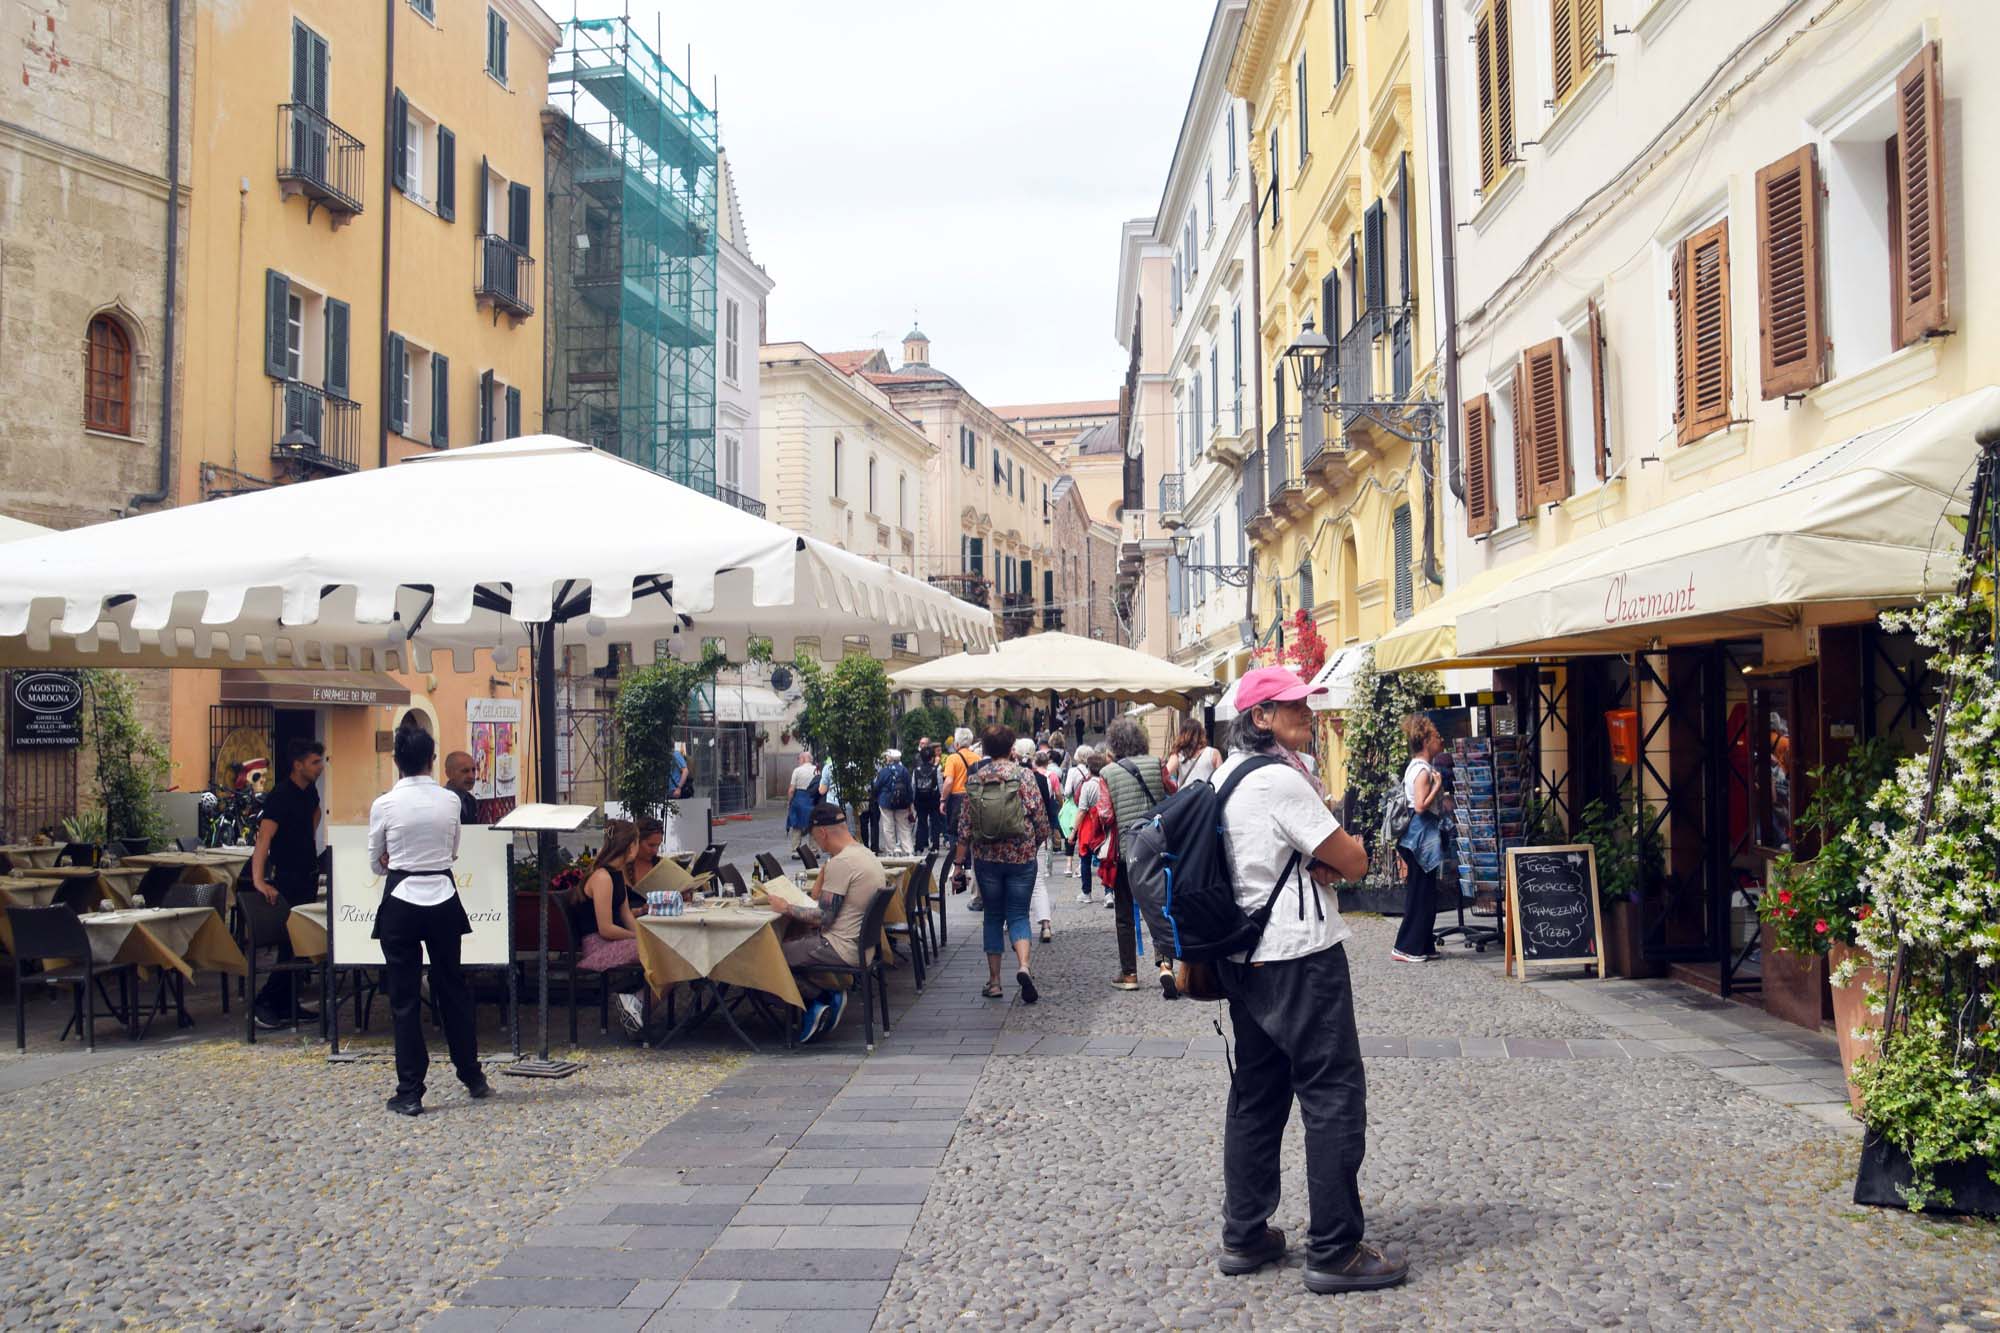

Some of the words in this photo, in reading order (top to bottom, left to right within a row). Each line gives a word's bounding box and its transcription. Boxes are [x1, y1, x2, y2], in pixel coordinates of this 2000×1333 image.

[1604, 570, 1696, 624] Charmant
[28, 684, 70, 693] AGOSTINO
[28, 694, 70, 702] MAROGNA
[1520, 859, 1561, 874] TOAST
[1523, 877, 1577, 893] FOCACCE
[1524, 900, 1583, 917] TRAMEZZINI
[1535, 921, 1572, 938] PIZZA
